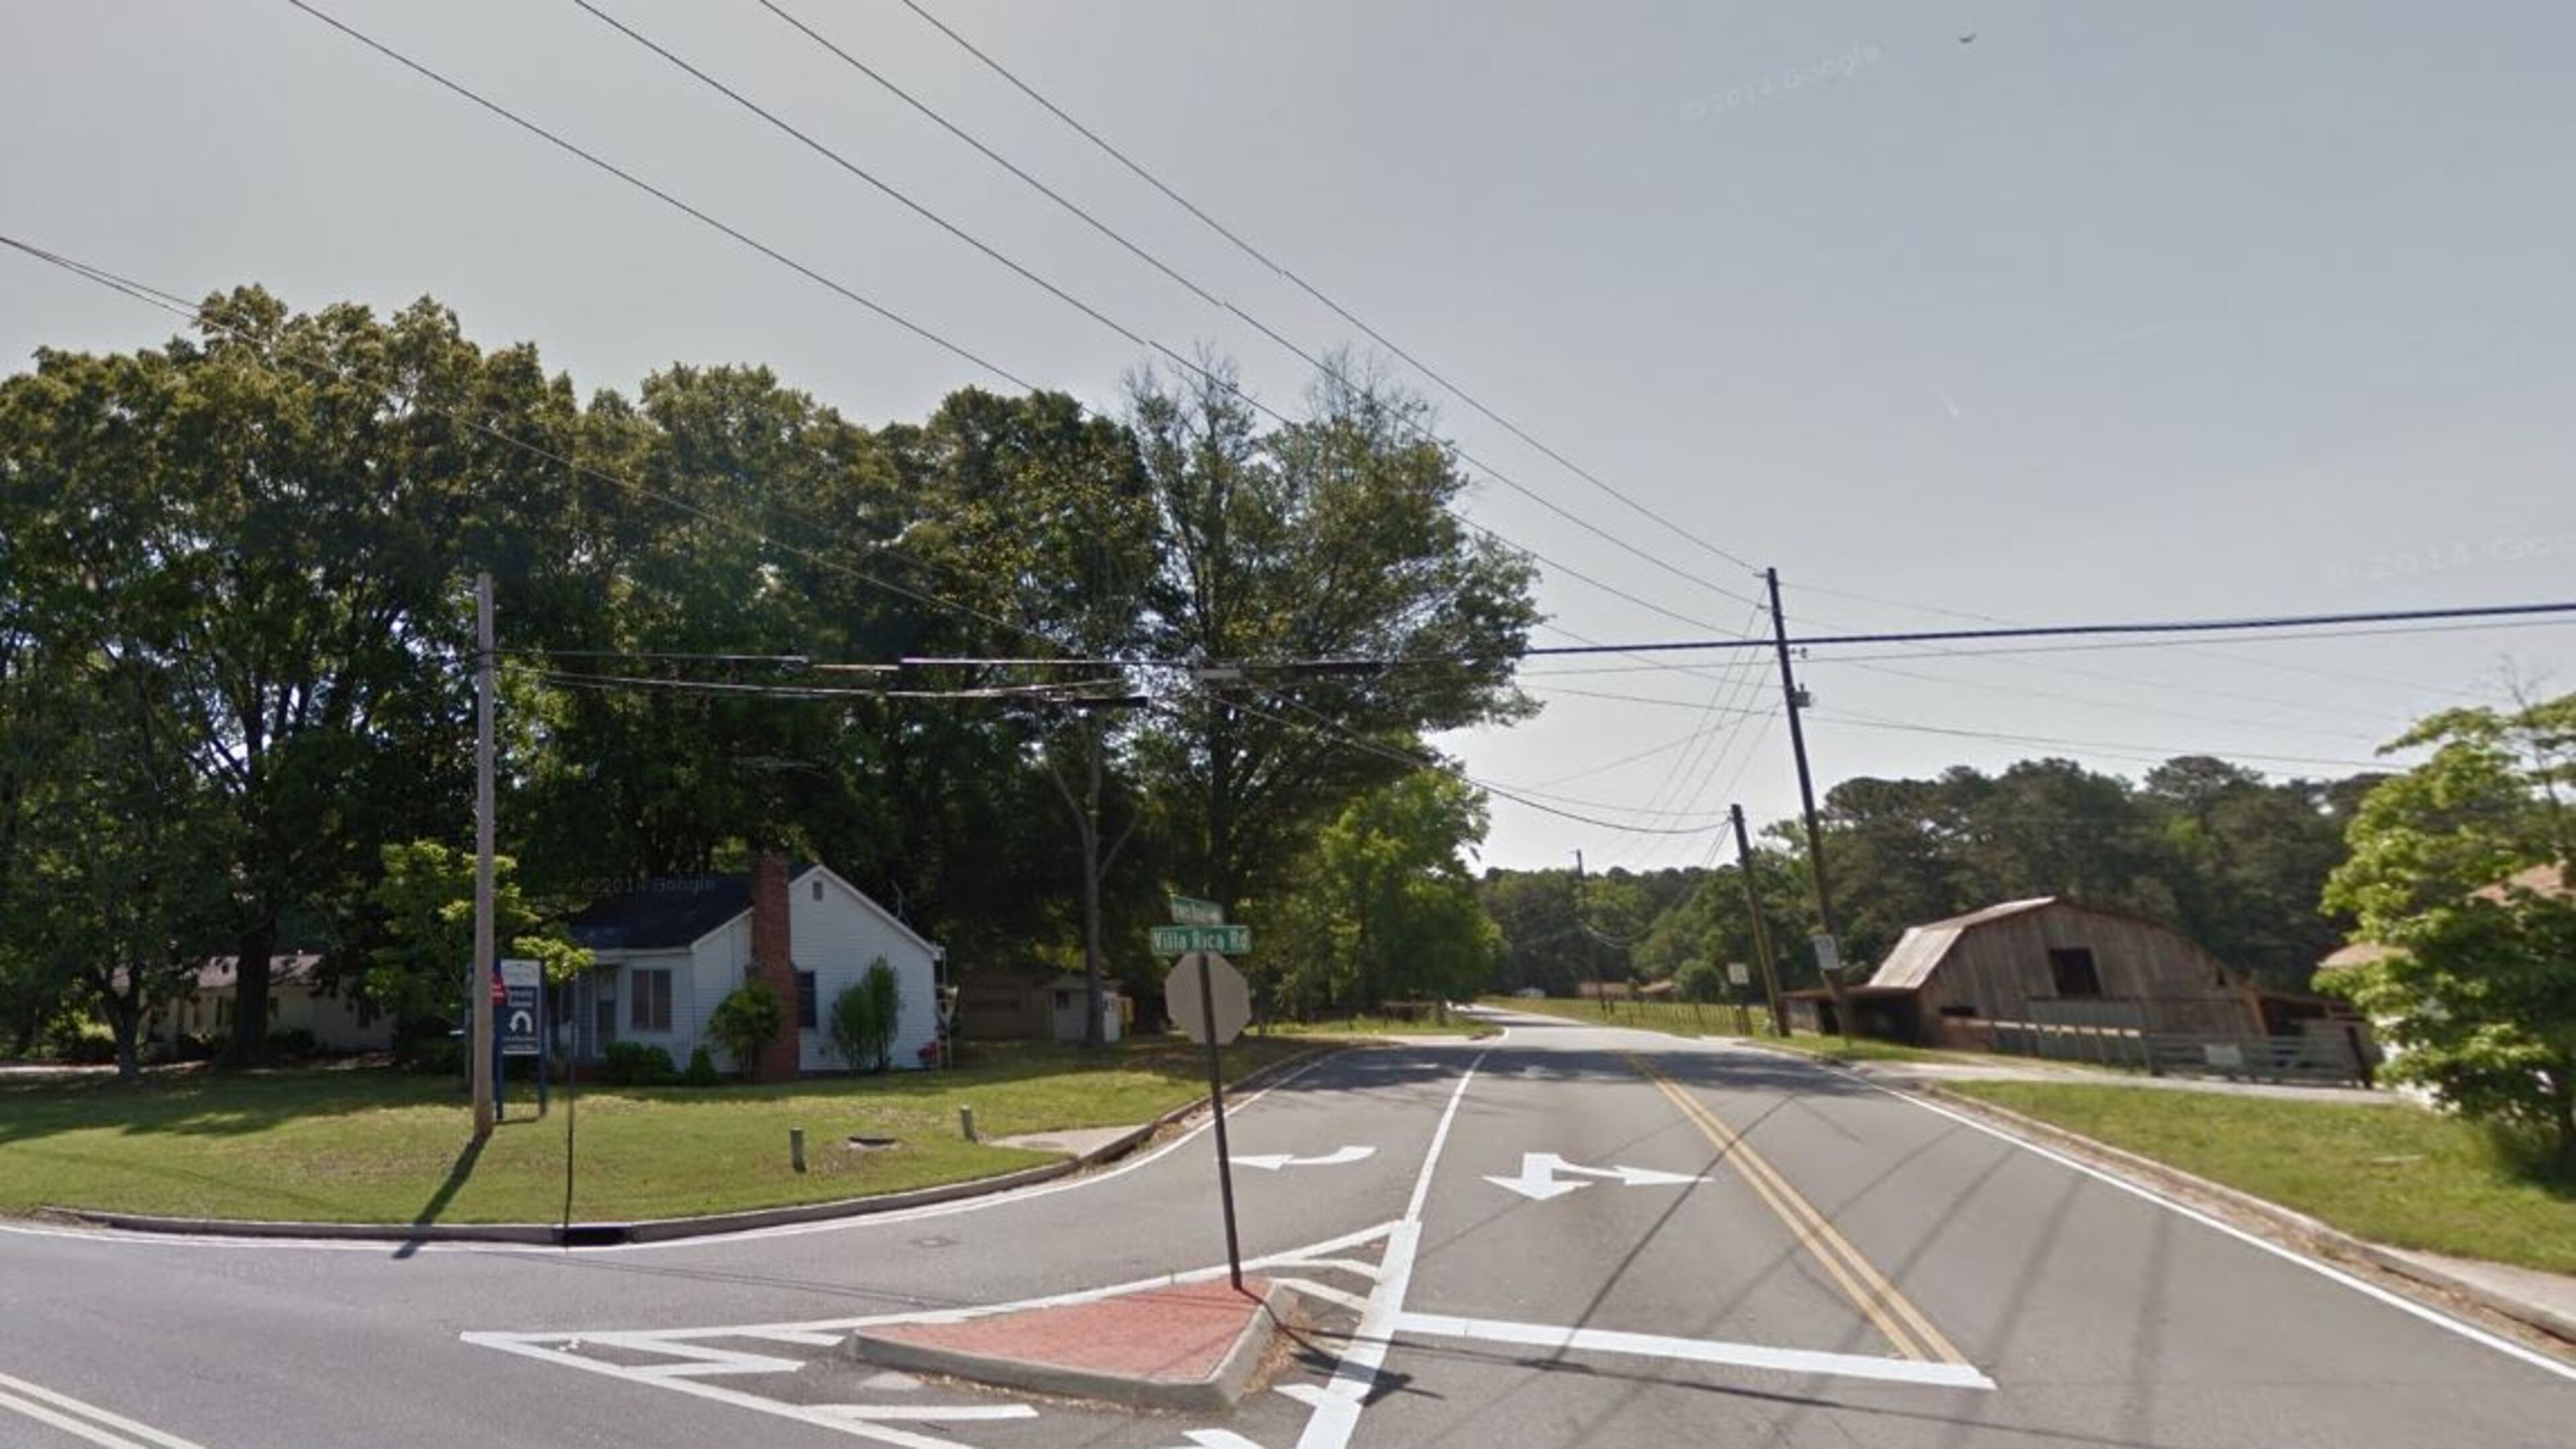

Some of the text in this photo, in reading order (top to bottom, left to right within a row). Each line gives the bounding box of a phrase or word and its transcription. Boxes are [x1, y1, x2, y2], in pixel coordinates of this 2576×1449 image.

[1153, 930, 1248, 949] Villa Rica Rd
